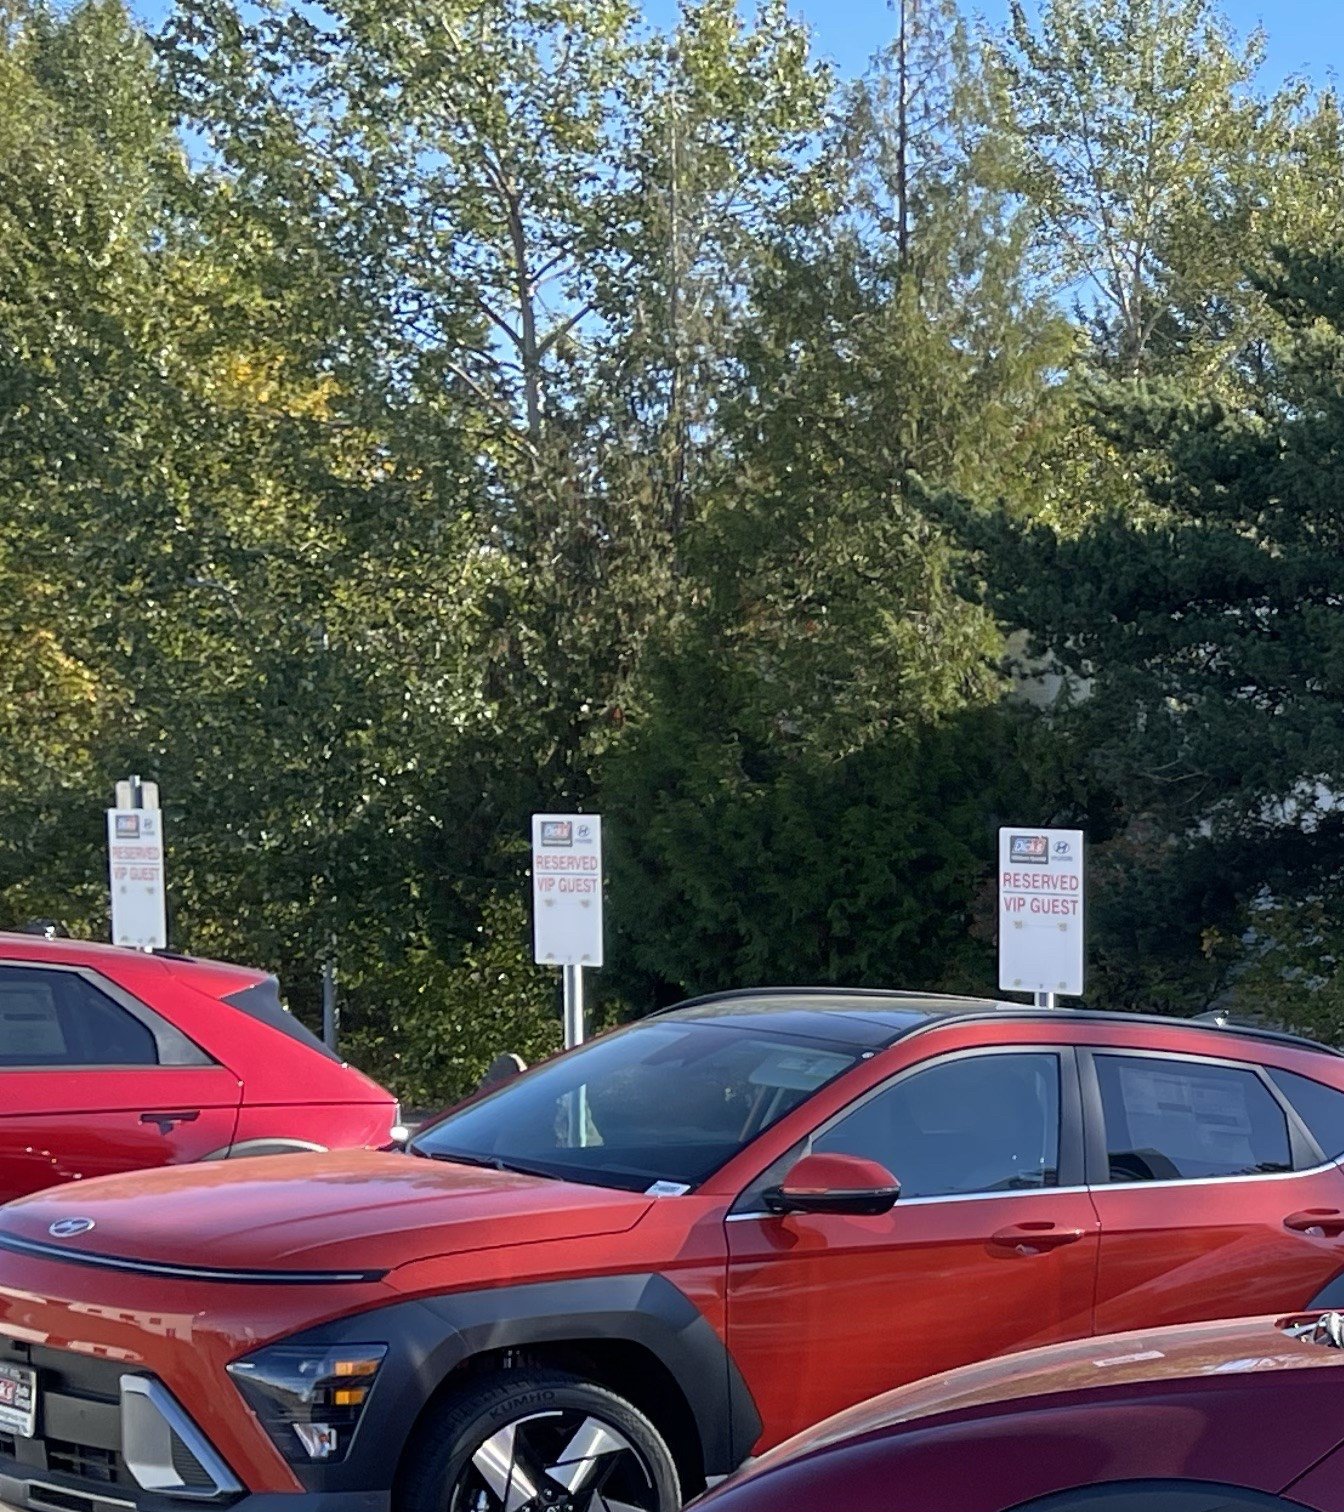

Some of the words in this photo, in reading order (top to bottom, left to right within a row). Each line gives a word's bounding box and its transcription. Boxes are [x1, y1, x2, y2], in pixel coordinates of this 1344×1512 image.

[535, 854, 598, 871] RESERVED
[537, 877, 555, 892] VIP
[558, 877, 598, 893] GUEST
[1002, 871, 1079, 891] RESERVED
[1003, 896, 1026, 913] VIP
[1030, 897, 1079, 916] GUEST
